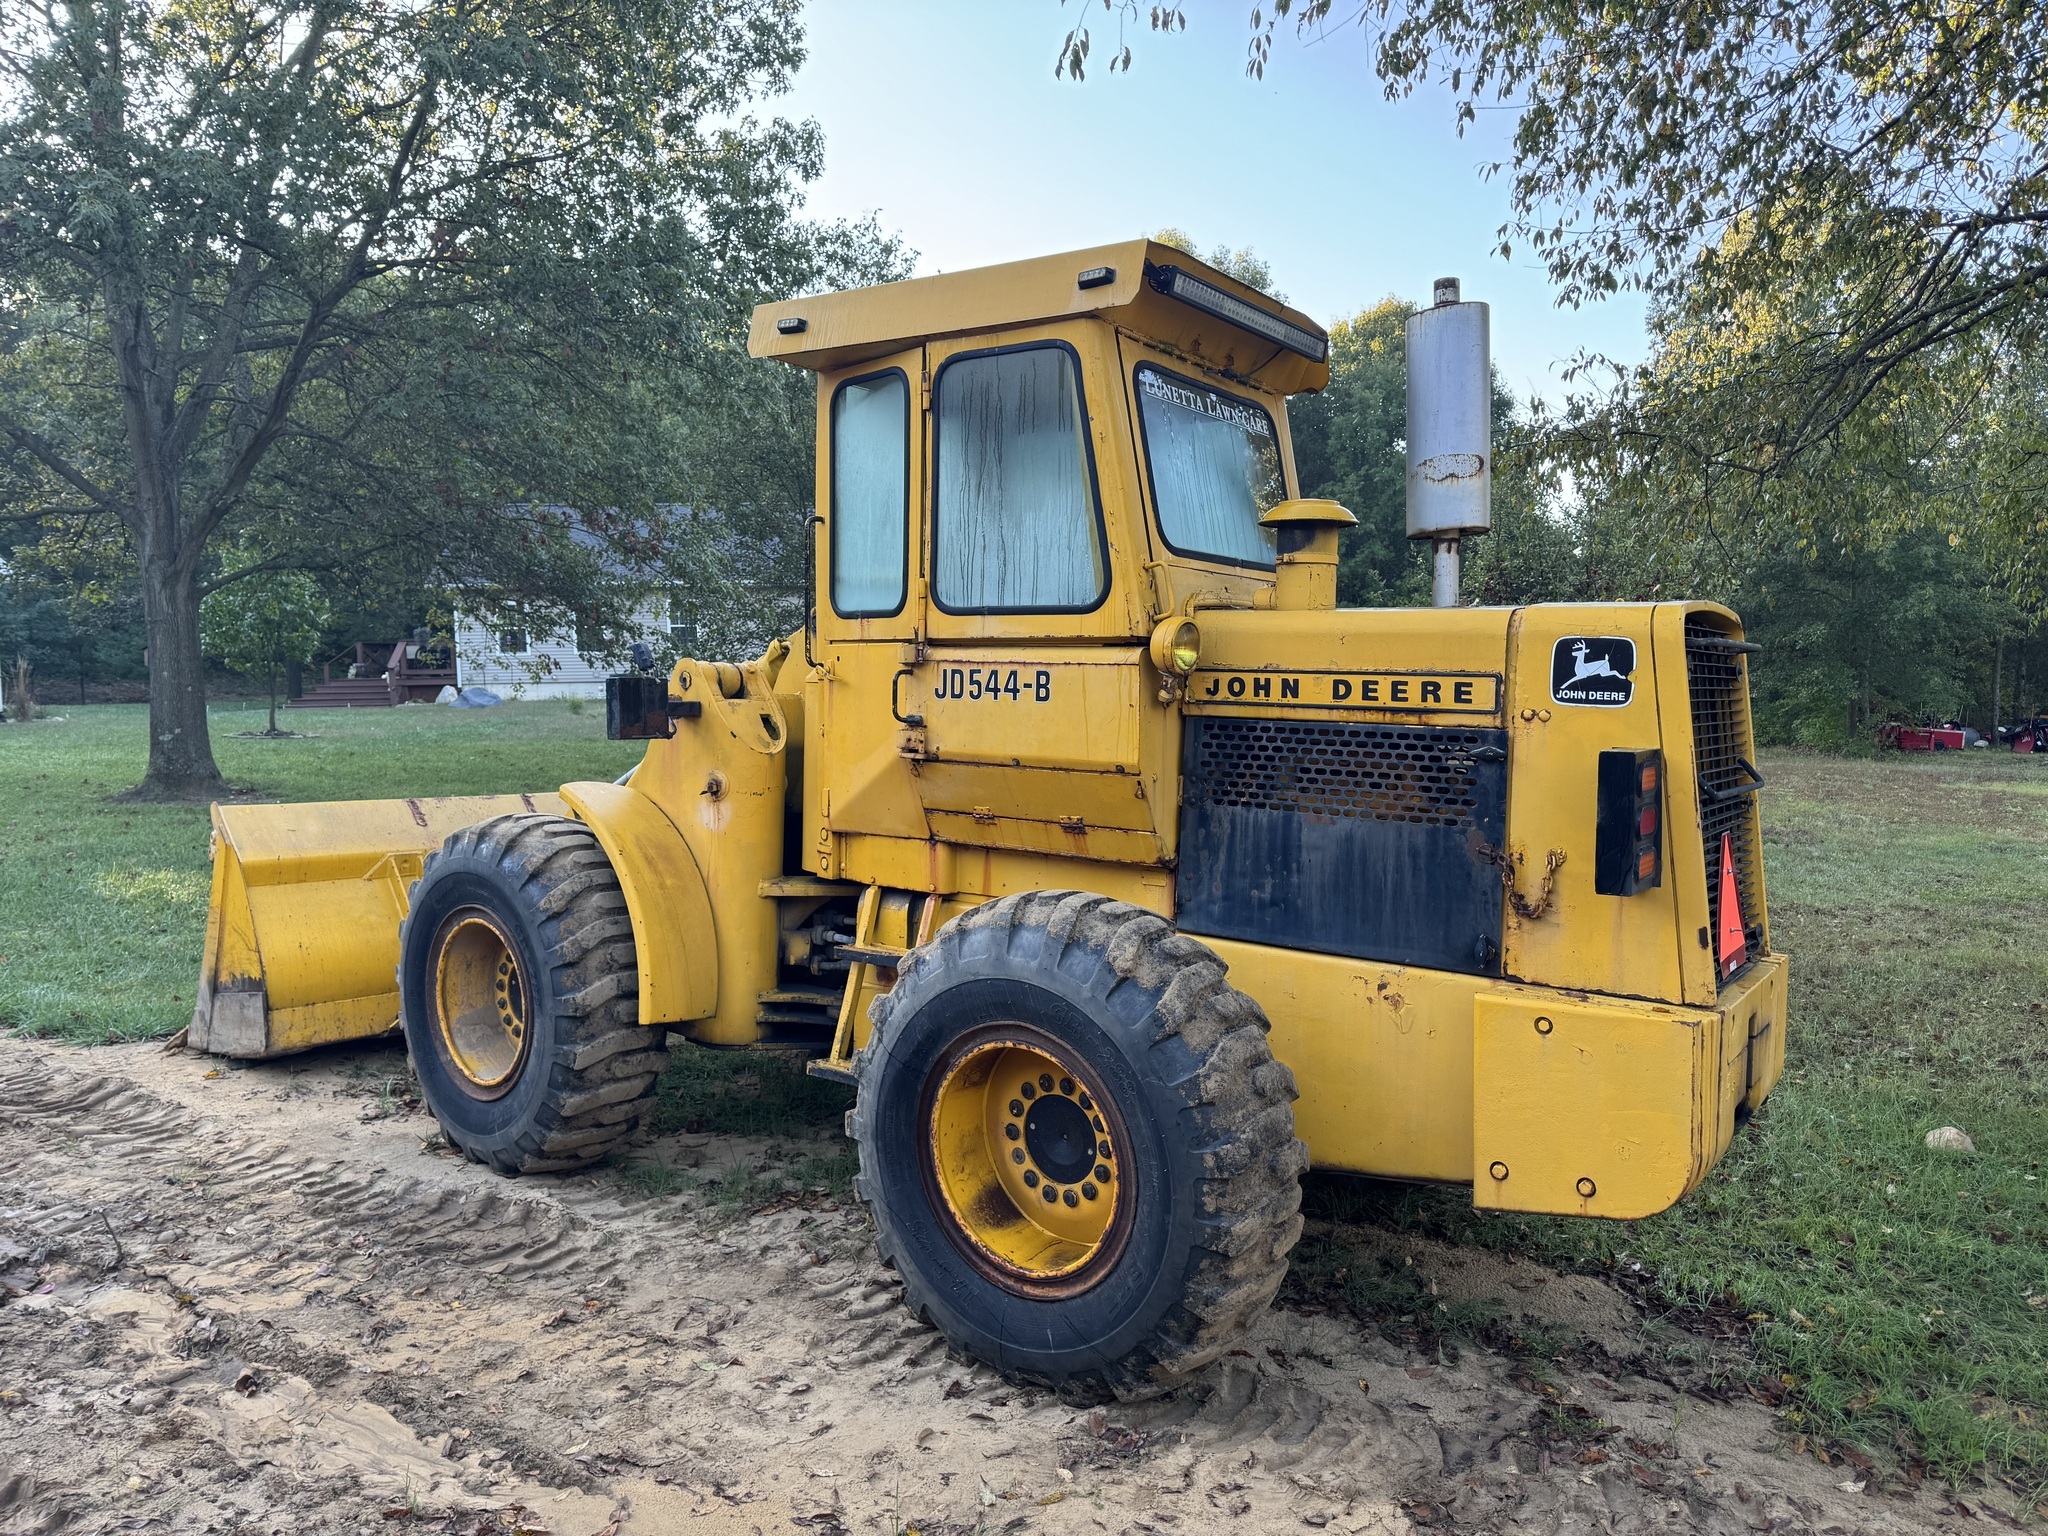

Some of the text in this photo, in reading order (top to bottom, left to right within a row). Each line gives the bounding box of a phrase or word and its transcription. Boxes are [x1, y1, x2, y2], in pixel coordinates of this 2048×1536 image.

[1145, 376, 1270, 434] LUNETTA LAWN CARE
[934, 668, 1051, 702] JD544-B
[1205, 676, 1474, 704] JOHN DEERE
[1556, 690, 1626, 701] JOHN DEERE
